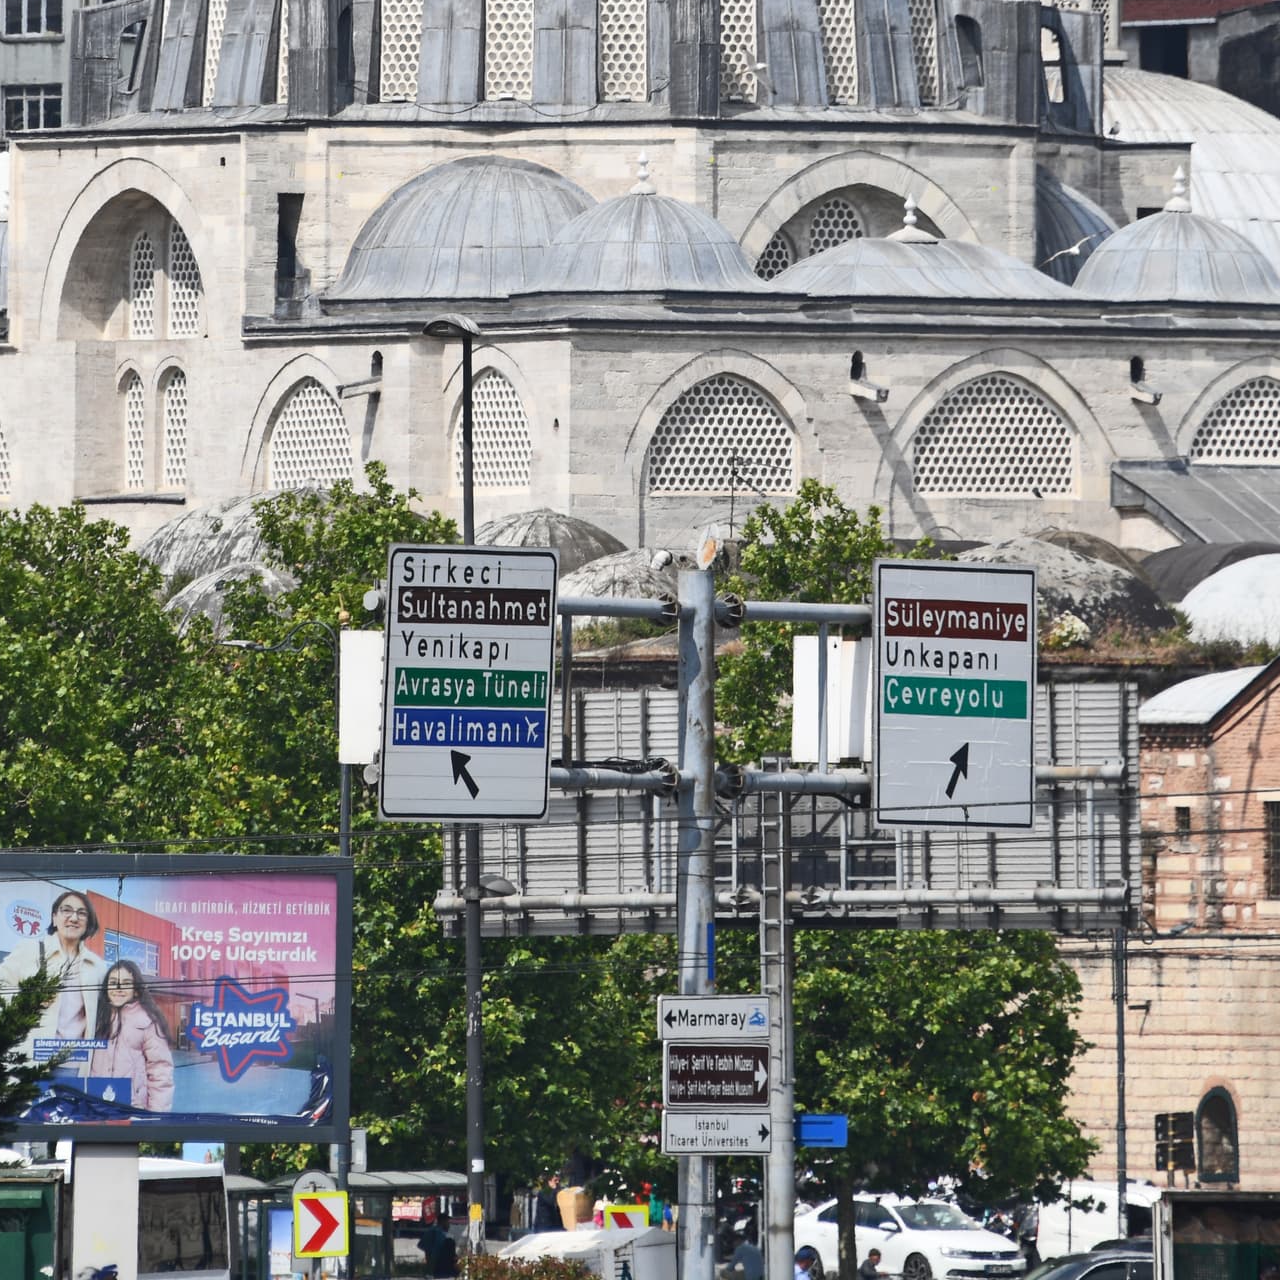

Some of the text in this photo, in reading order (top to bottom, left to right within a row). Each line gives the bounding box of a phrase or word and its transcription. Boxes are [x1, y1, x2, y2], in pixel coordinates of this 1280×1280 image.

[403, 556, 502, 585] Sirkeci
[401, 591, 547, 621] Sultanahmet
[887, 600, 1026, 639] Süleymaniye
[401, 630, 509, 668] Yenikapı
[886, 641, 998, 677] Unkapanı
[396, 669, 546, 705] Avrasya Tüneli
[886, 678, 1004, 715] Çevreyolu
[394, 712, 520, 744] Havalimanı
[181, 925, 308, 947] Kreş Sayımızı
[171, 945, 318, 965] 100'e Ulaştırdık
[195, 1007, 291, 1028] İSTANBUL
[678, 1009, 746, 1031] Marmaray
[200, 1023, 280, 1048] Başardı
[670, 1133, 698, 1147] Ticaret
